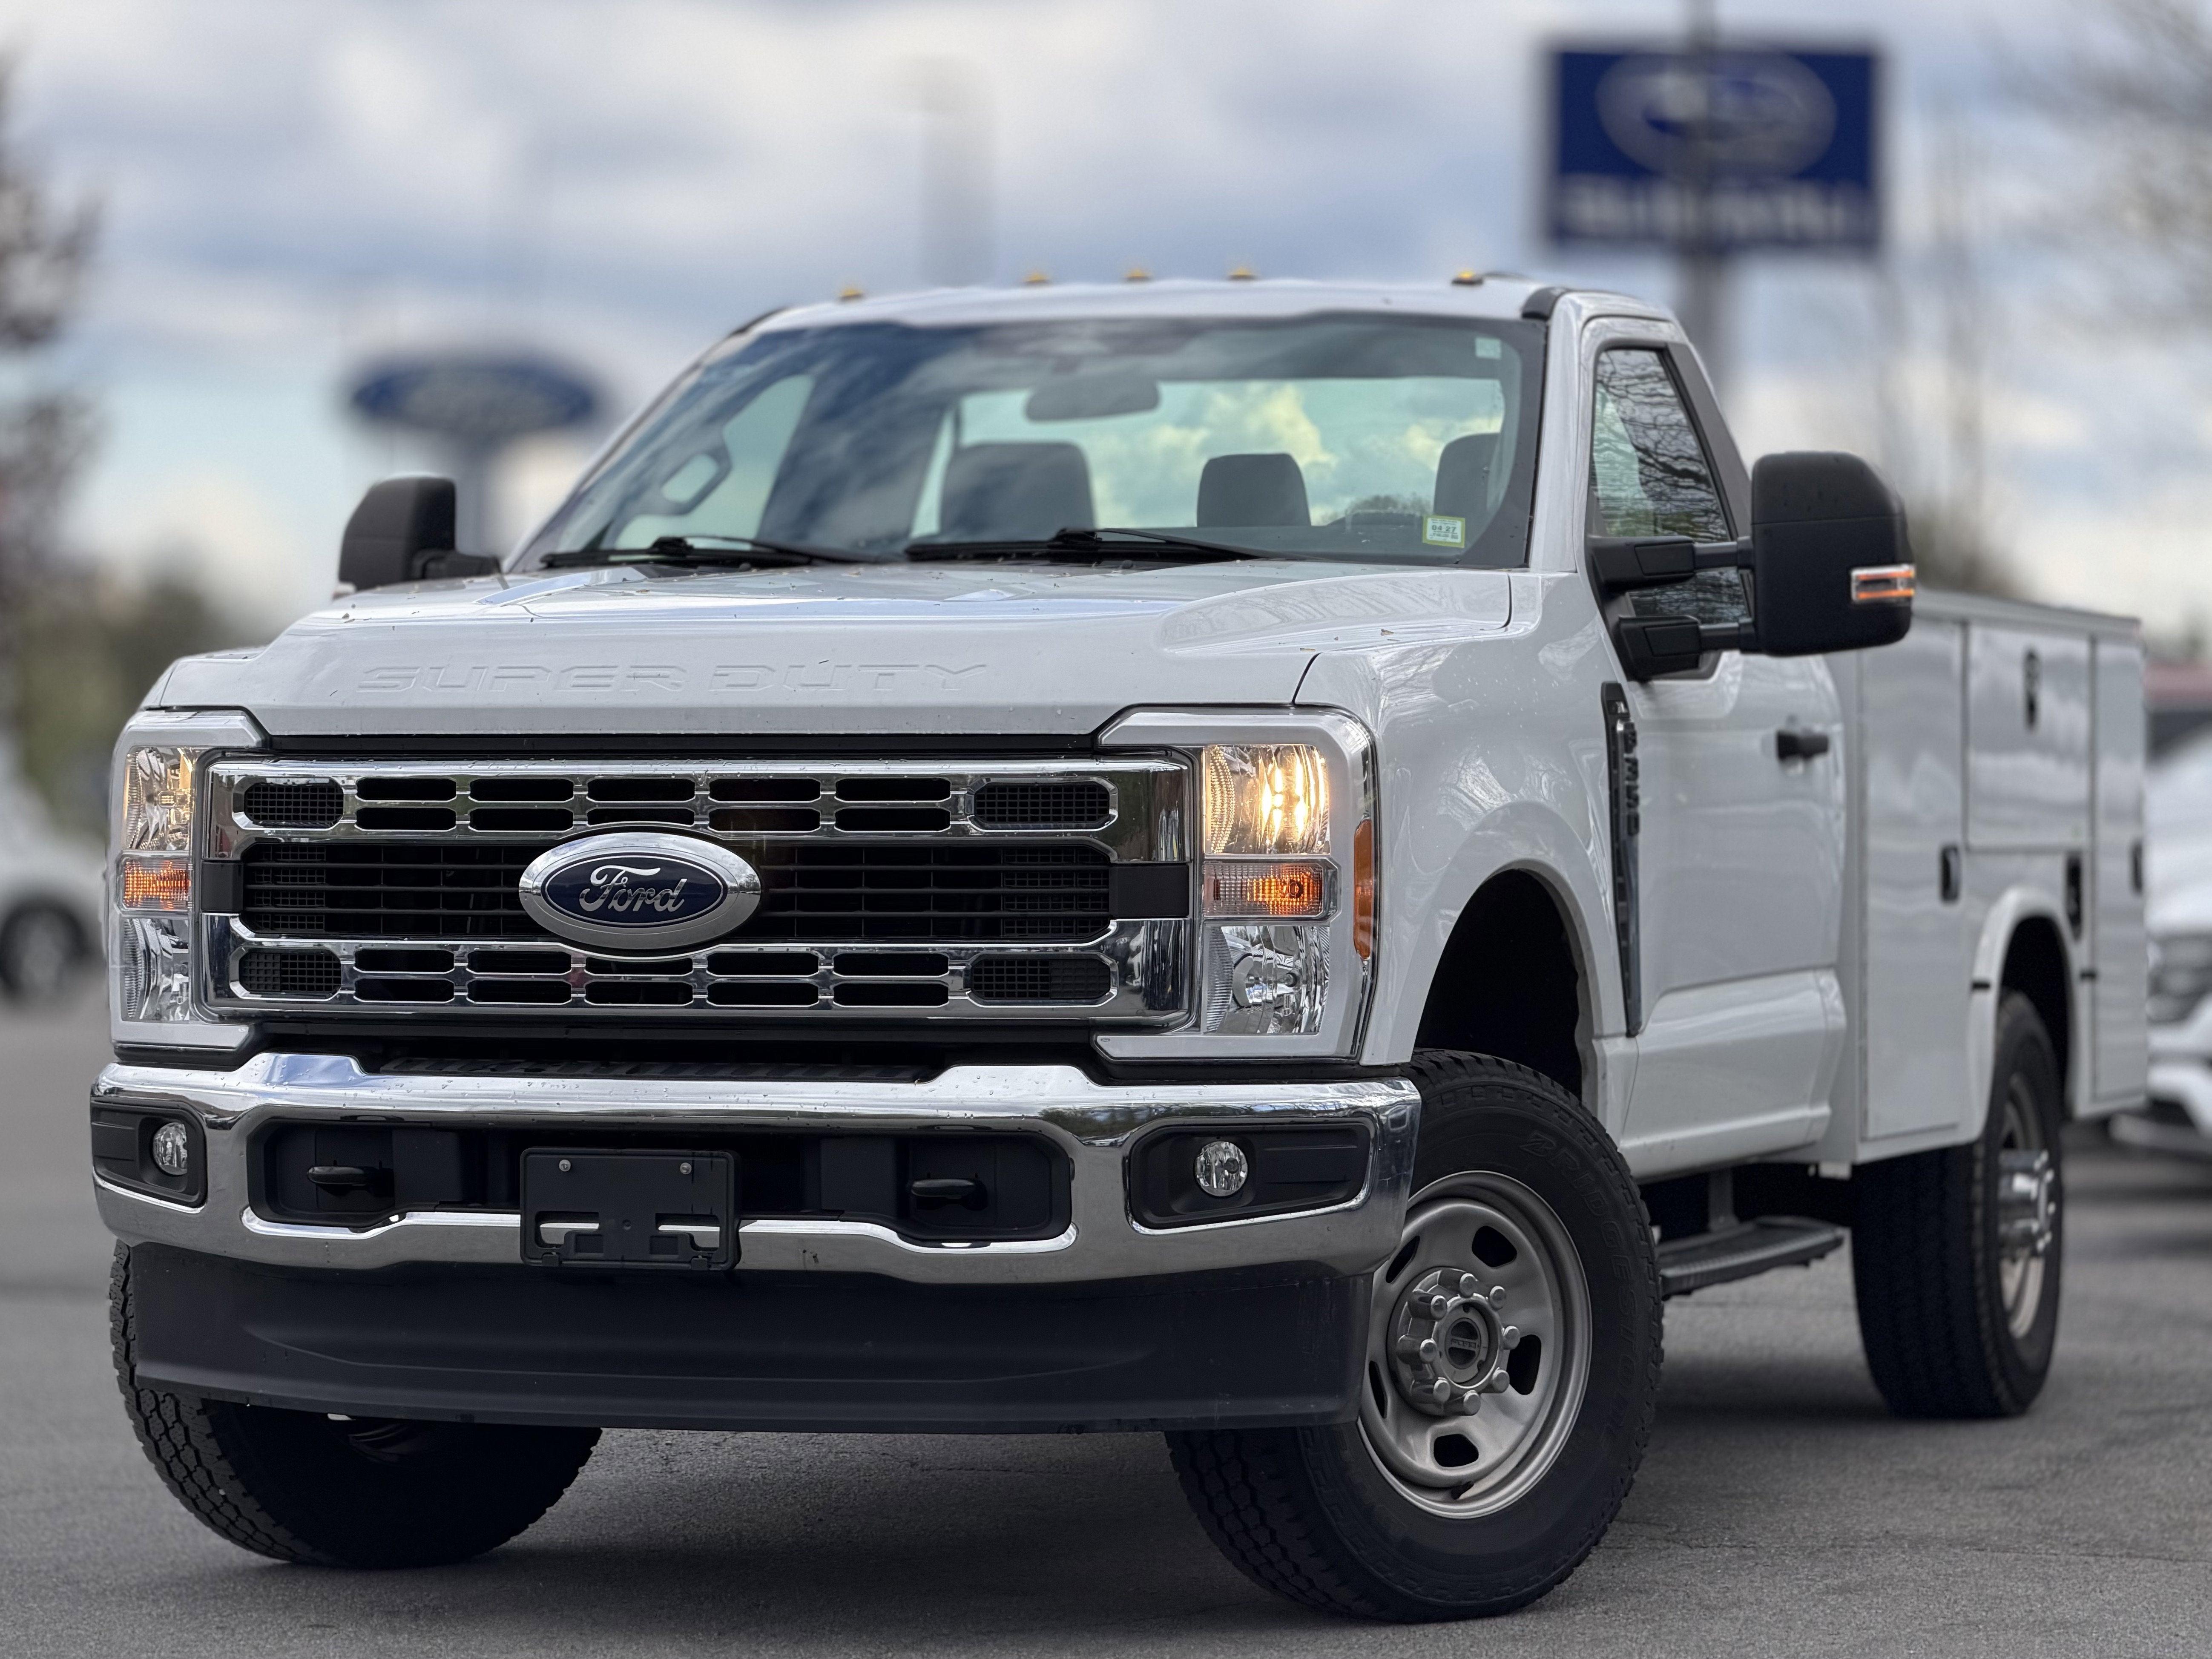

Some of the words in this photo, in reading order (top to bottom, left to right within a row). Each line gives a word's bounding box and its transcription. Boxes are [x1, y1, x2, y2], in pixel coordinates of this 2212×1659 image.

[357, 666, 687, 692] SUPER
[710, 664, 987, 691] DUTY
[579, 865, 687, 911] Ford
